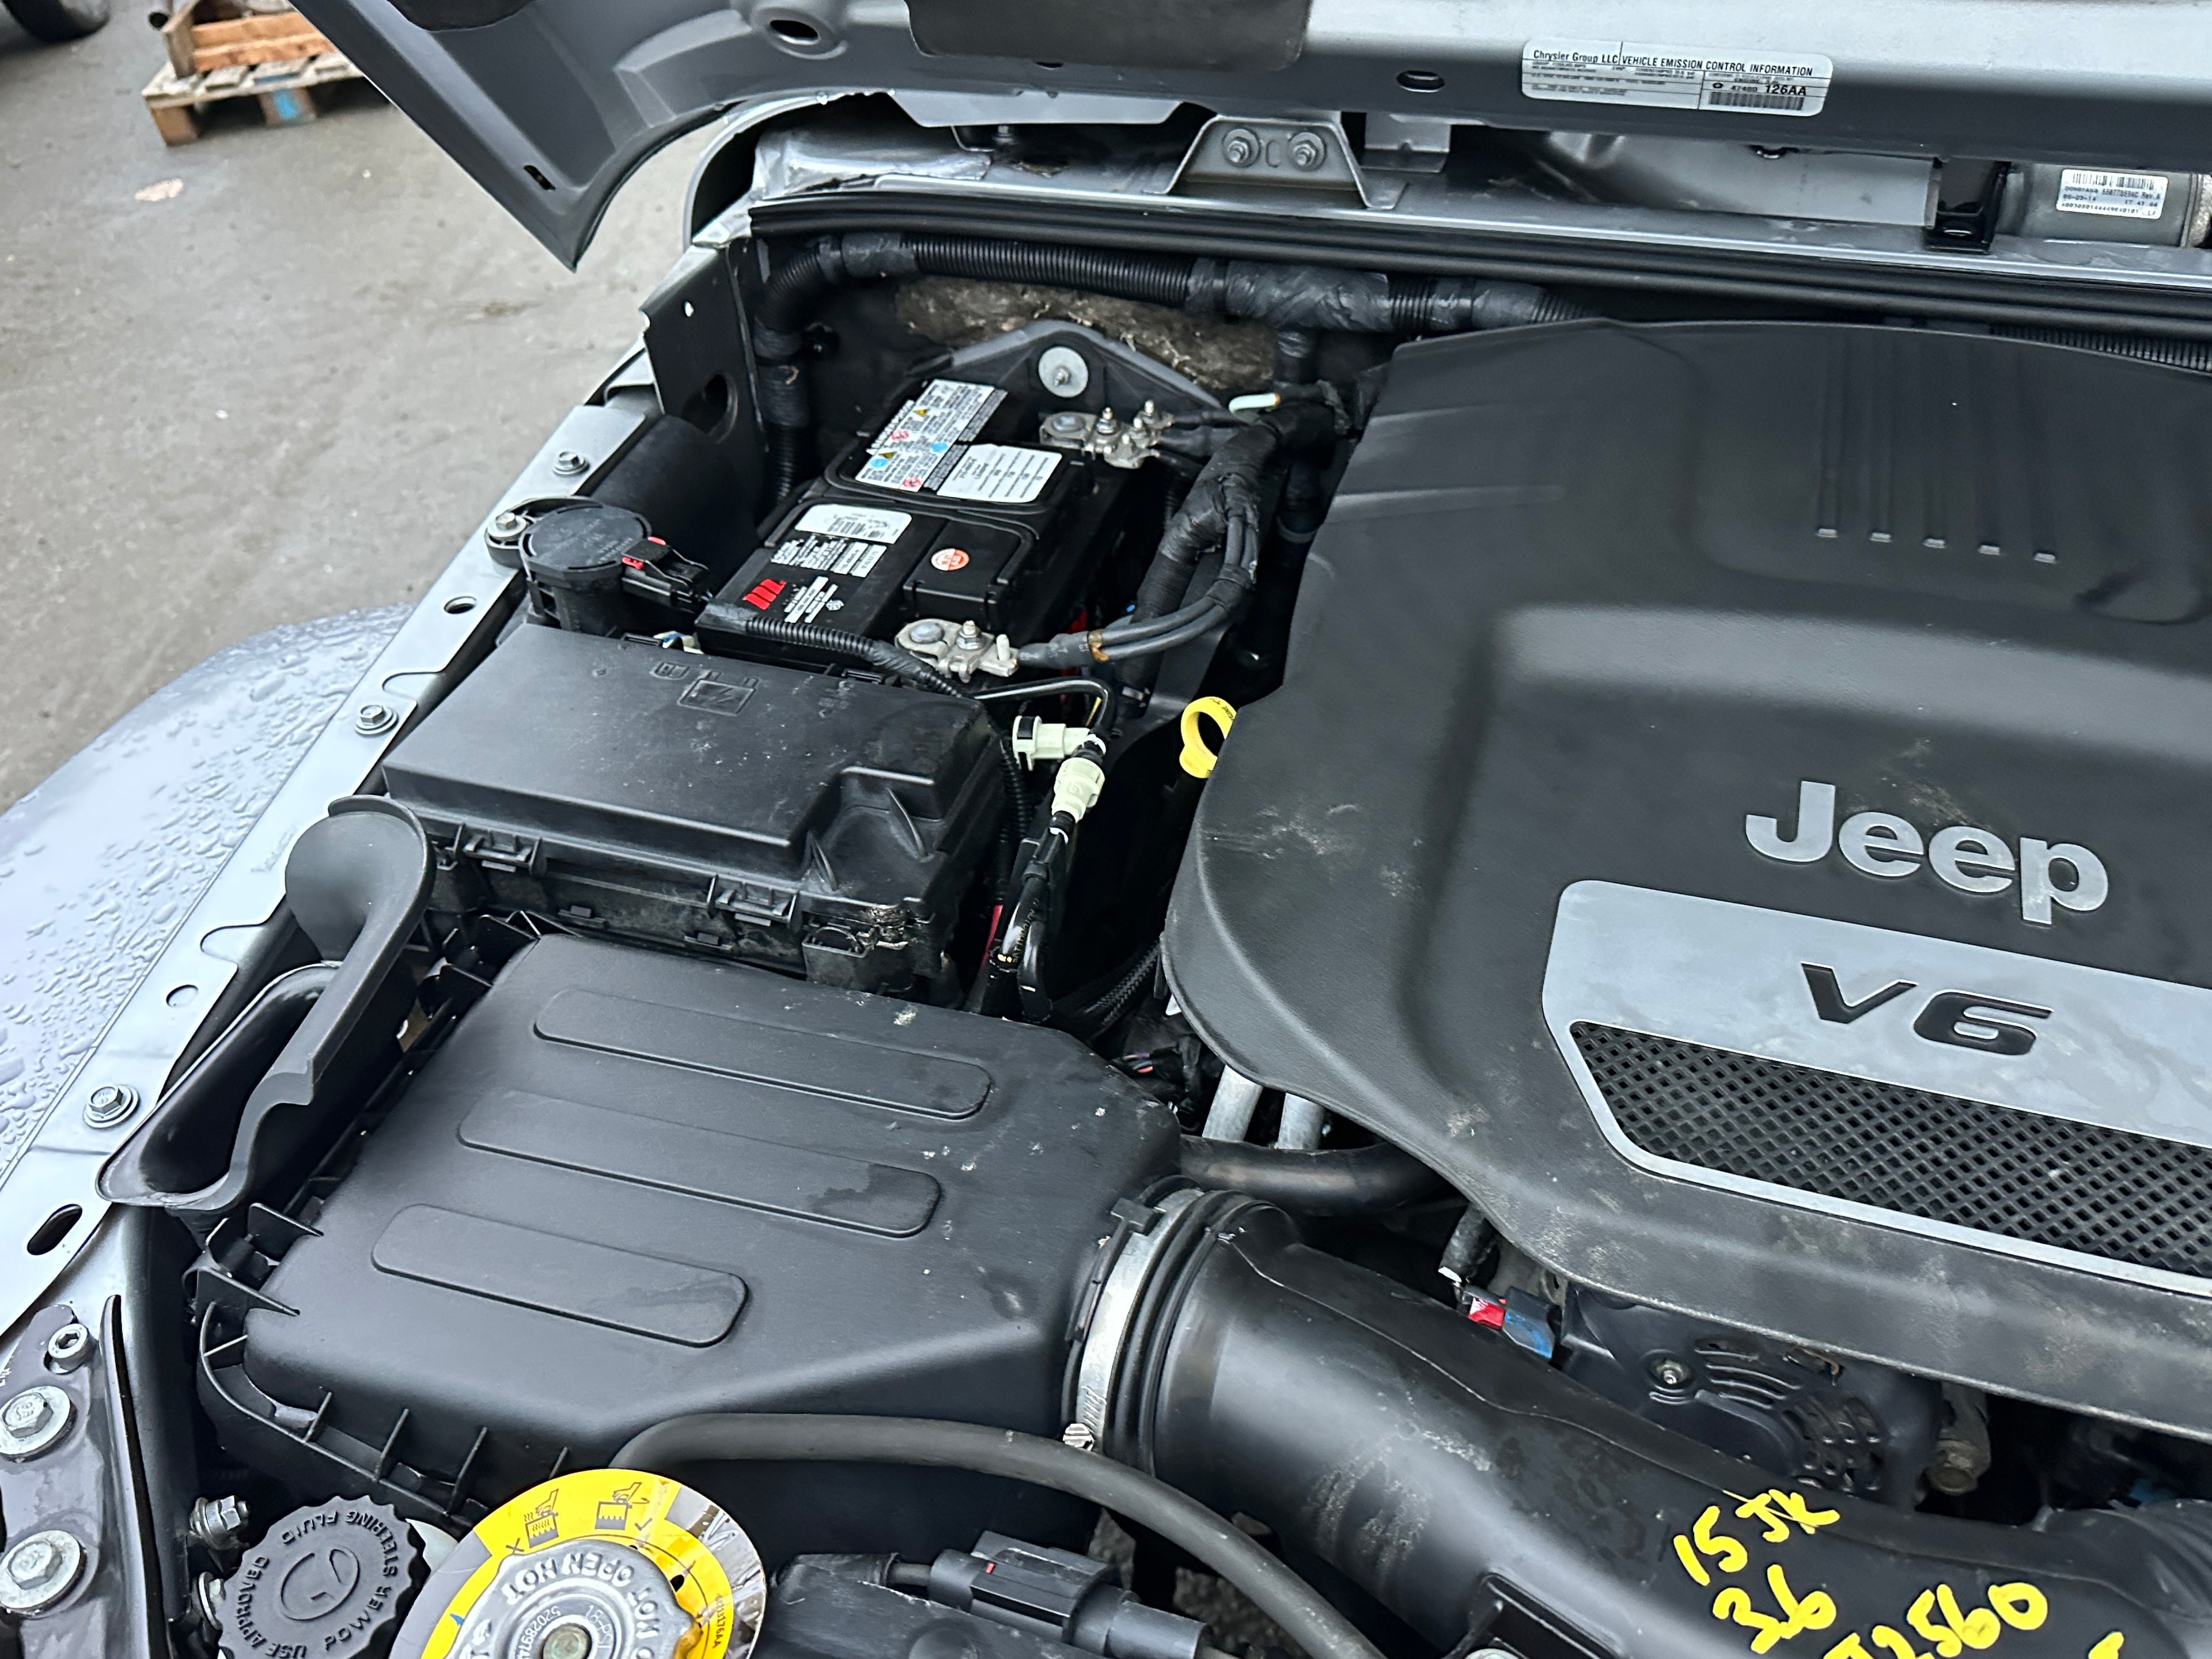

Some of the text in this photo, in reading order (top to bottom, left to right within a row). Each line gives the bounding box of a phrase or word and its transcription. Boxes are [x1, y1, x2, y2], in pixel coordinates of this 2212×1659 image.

[1533, 50, 1618, 63] Chrysler Group LLC
[1622, 55, 1813, 76] VEHICLE EMISSION CONTROL INFORMATION
[1766, 84, 1806, 96] 126AA
[1745, 781, 2109, 925] Jeep
[1801, 961, 2054, 1056] V6
[1673, 1488, 1842, 1585] 15 JK
[235, 1510, 399, 1658] USE APPROVED POWER STEERING FLUID
[502, 1556, 558, 1605] HOT
[561, 1552, 635, 1586] OPEN
[627, 1586, 660, 1640] NOT
